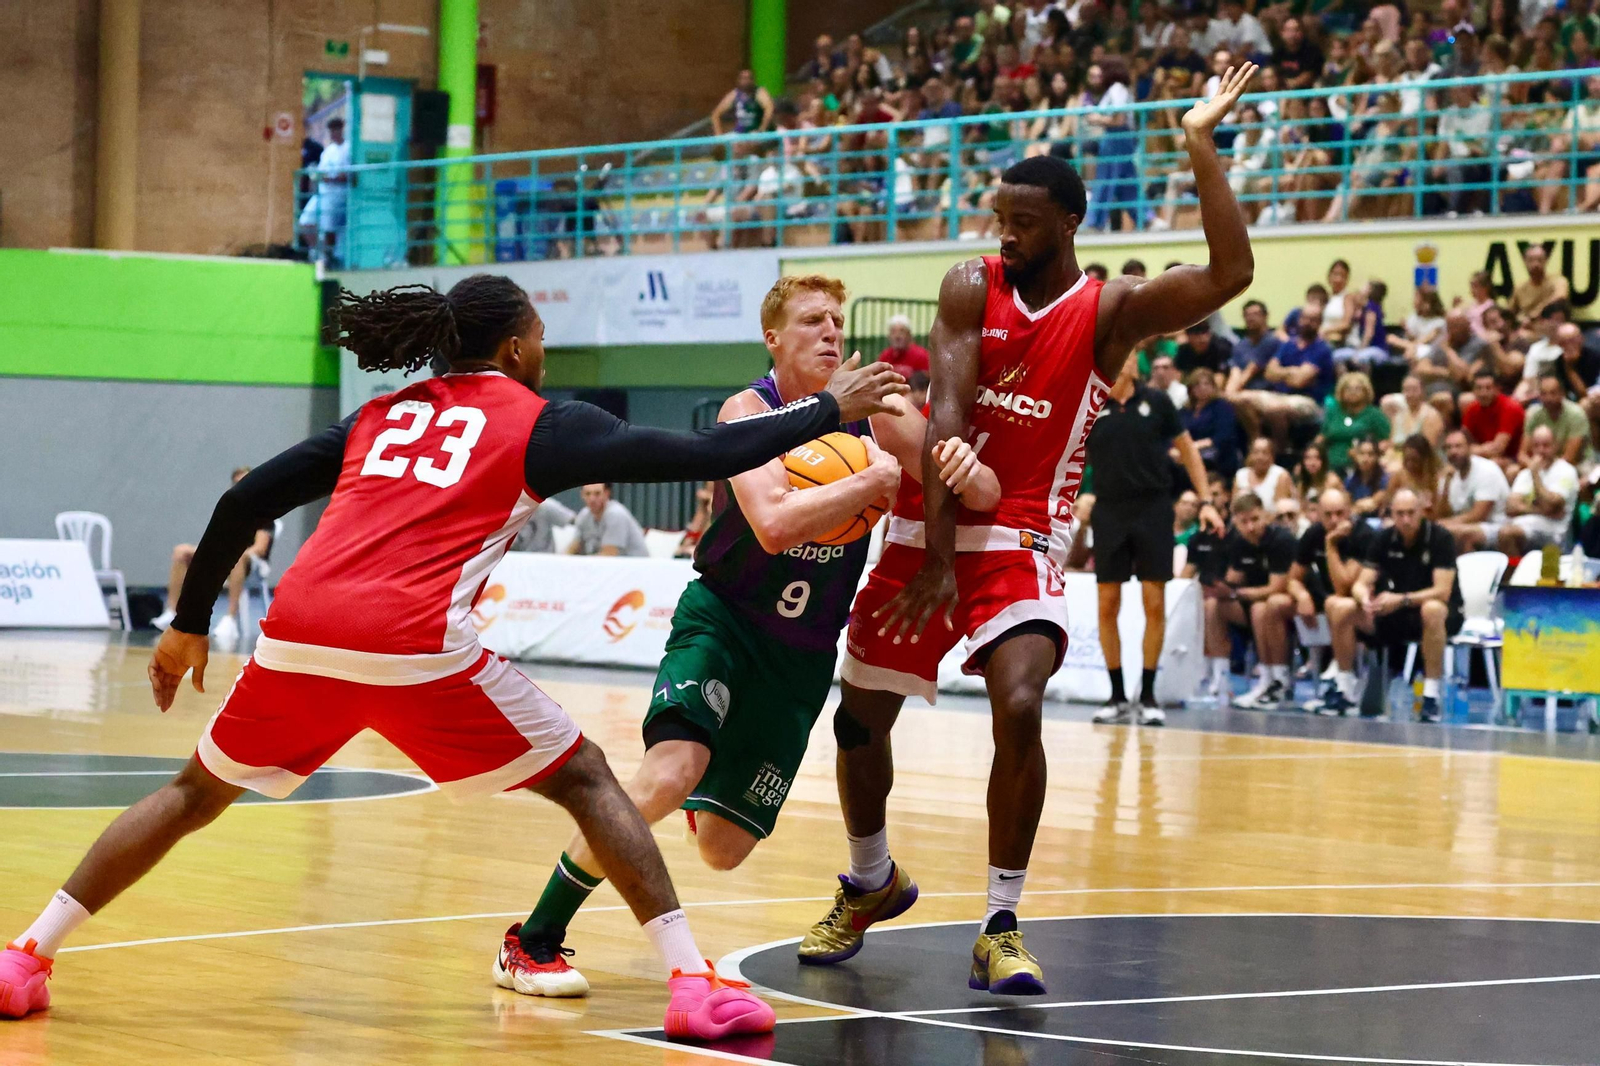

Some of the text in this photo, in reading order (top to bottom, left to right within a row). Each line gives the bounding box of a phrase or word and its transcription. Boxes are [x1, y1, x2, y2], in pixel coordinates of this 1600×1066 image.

[975, 384, 1053, 419] ONACO
[359, 399, 488, 489] 23
[776, 580, 811, 619] 9
